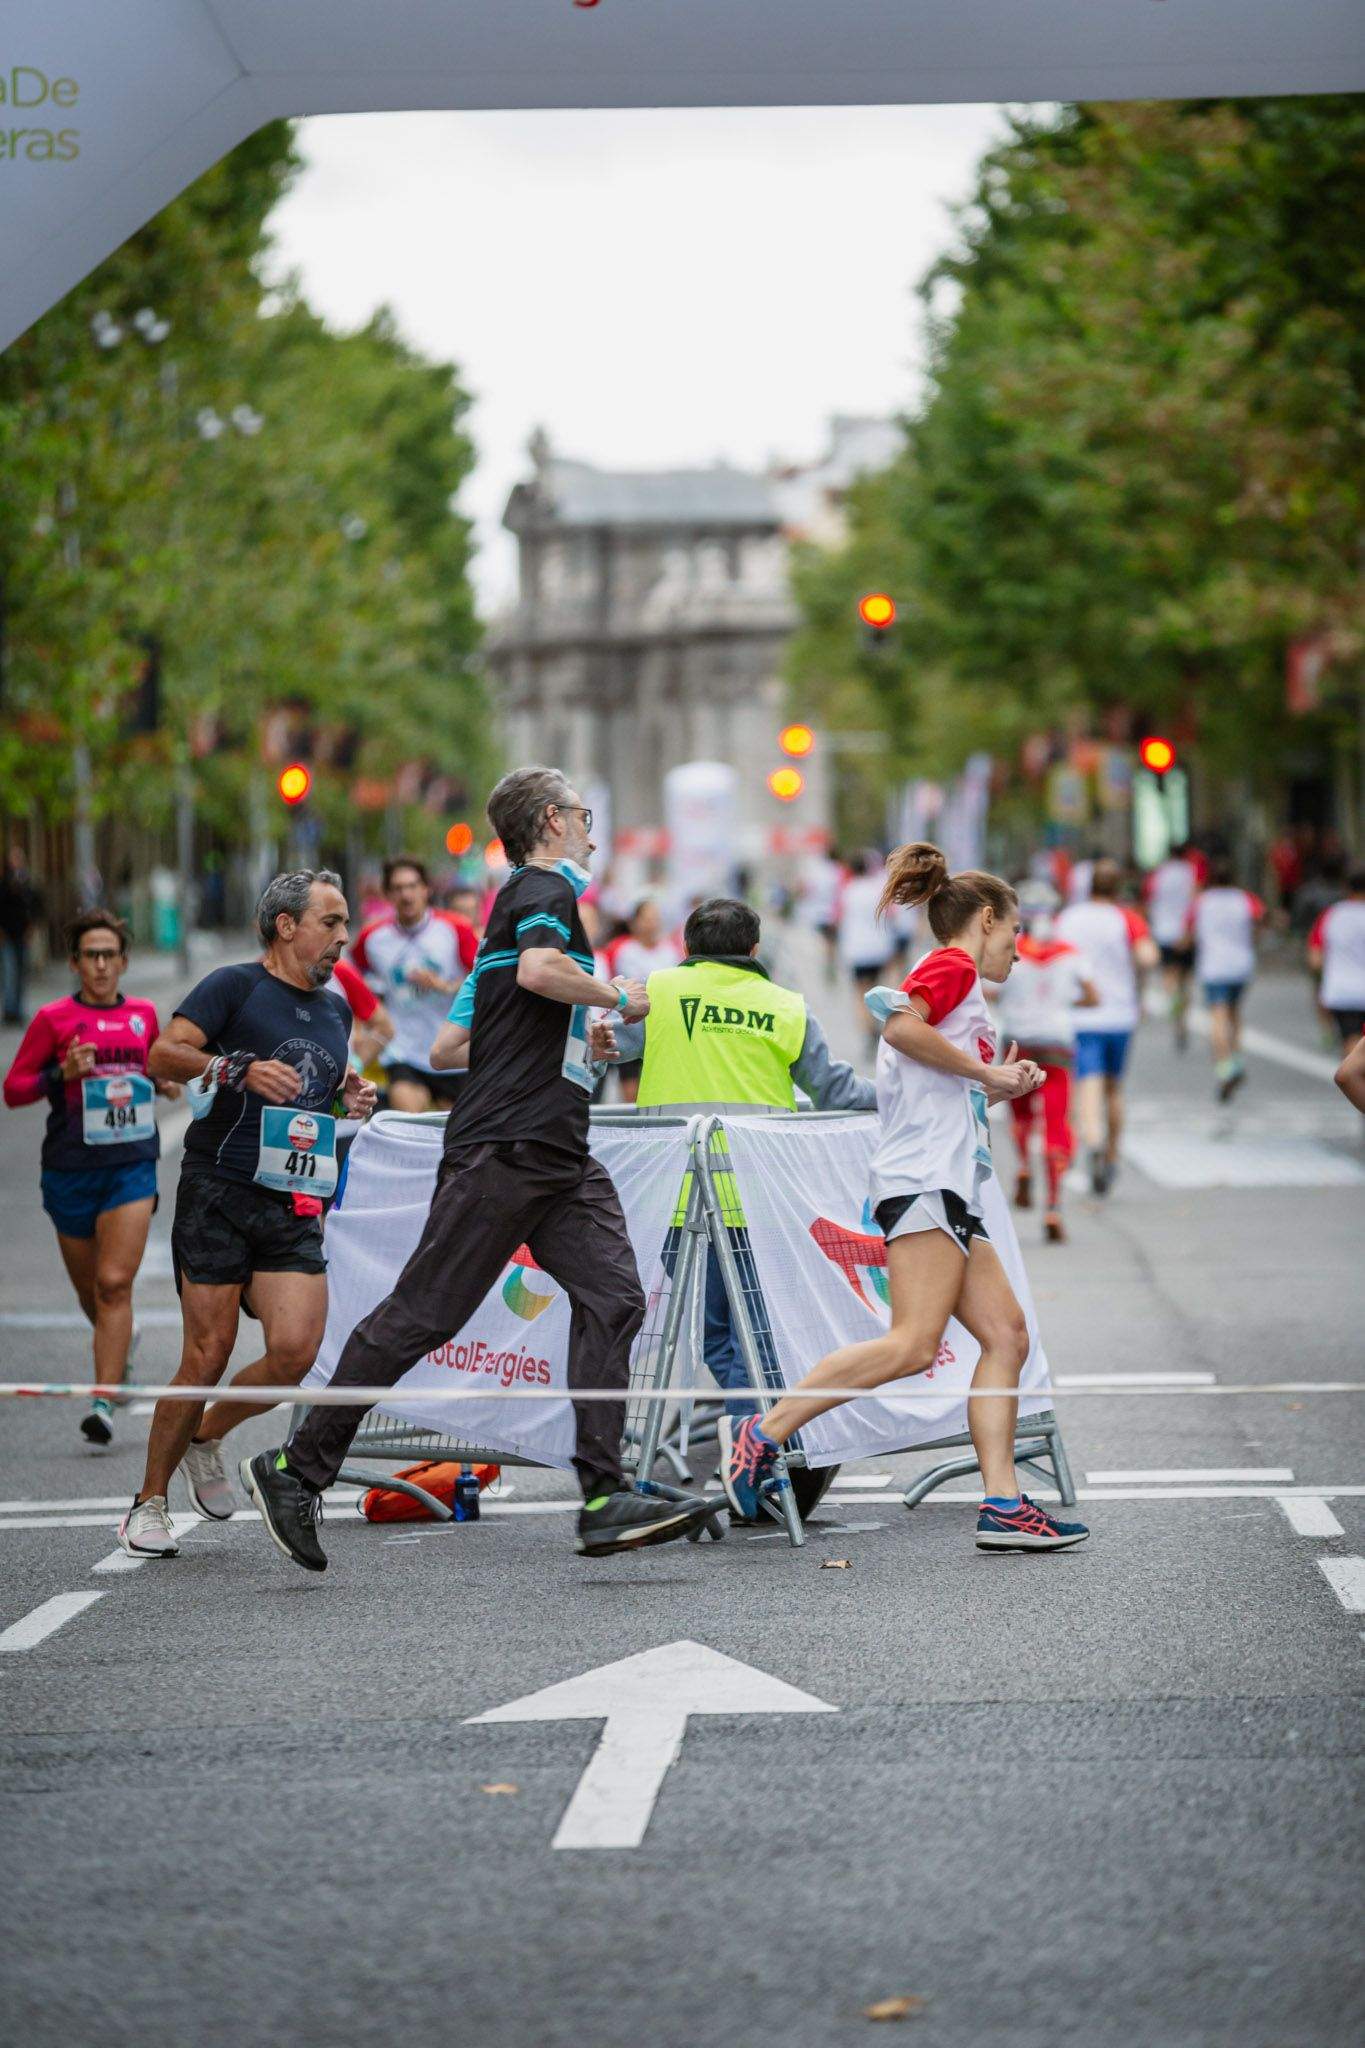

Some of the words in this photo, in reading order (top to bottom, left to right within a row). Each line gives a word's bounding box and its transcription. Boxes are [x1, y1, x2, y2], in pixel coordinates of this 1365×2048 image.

[0, 65, 80, 108] De
[0, 127, 80, 162] ras
[701, 1005, 776, 1033] ADM
[104, 1103, 137, 1129] 494
[284, 1151, 317, 1178] 411
